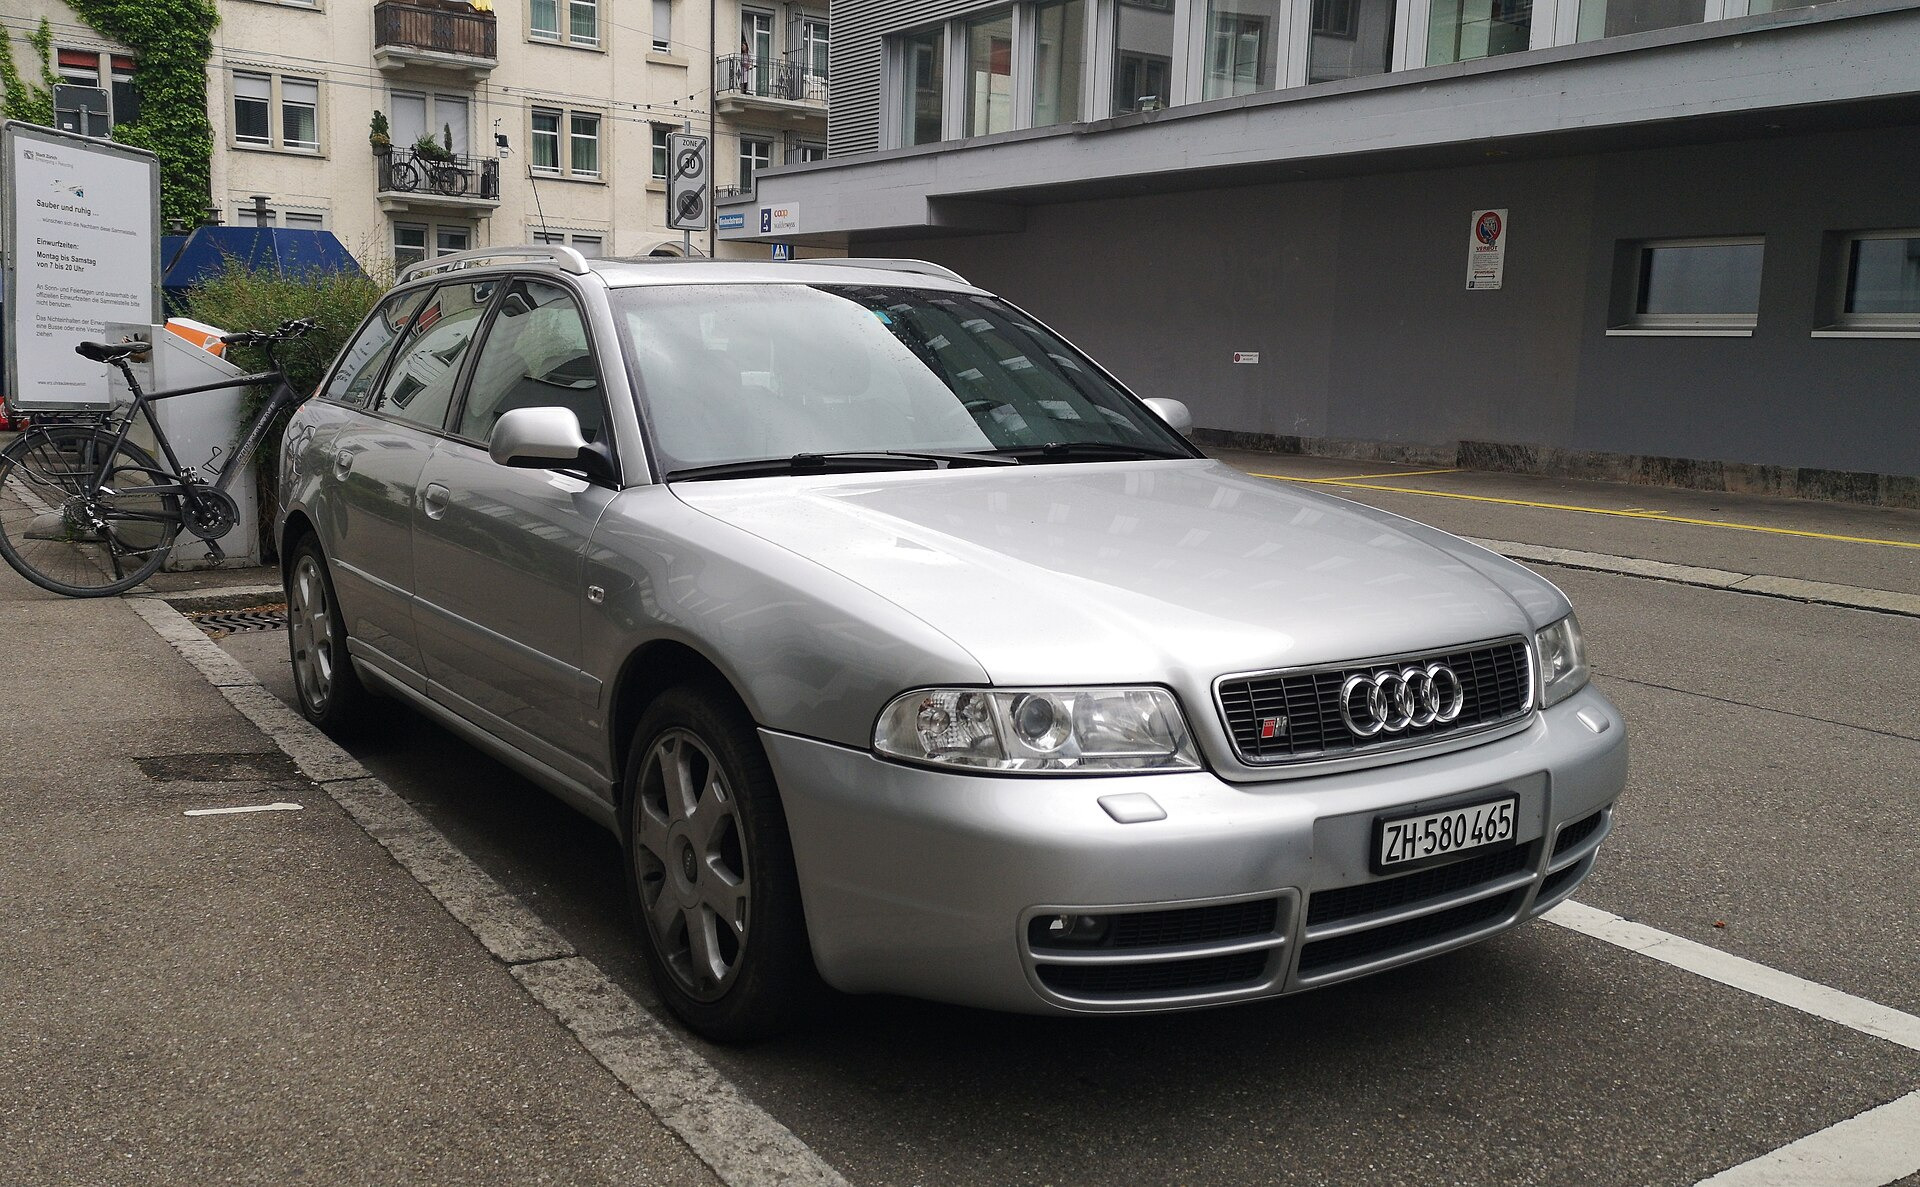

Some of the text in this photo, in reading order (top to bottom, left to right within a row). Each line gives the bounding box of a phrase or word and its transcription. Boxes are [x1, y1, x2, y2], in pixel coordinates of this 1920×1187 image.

[682, 139, 698, 147] ZONE
[685, 157, 696, 169] 30
[36, 199, 59, 210] Sauber
[74, 207, 91, 217] ruhig
[763, 213, 769, 224] P
[774, 209, 789, 219] coop
[36, 238, 79, 250] Einwurfzeiten:
[36, 251, 97, 267] Montag bis Samstag
[70, 287, 94, 296] Feiertagen
[48, 323, 63, 331] Busse
